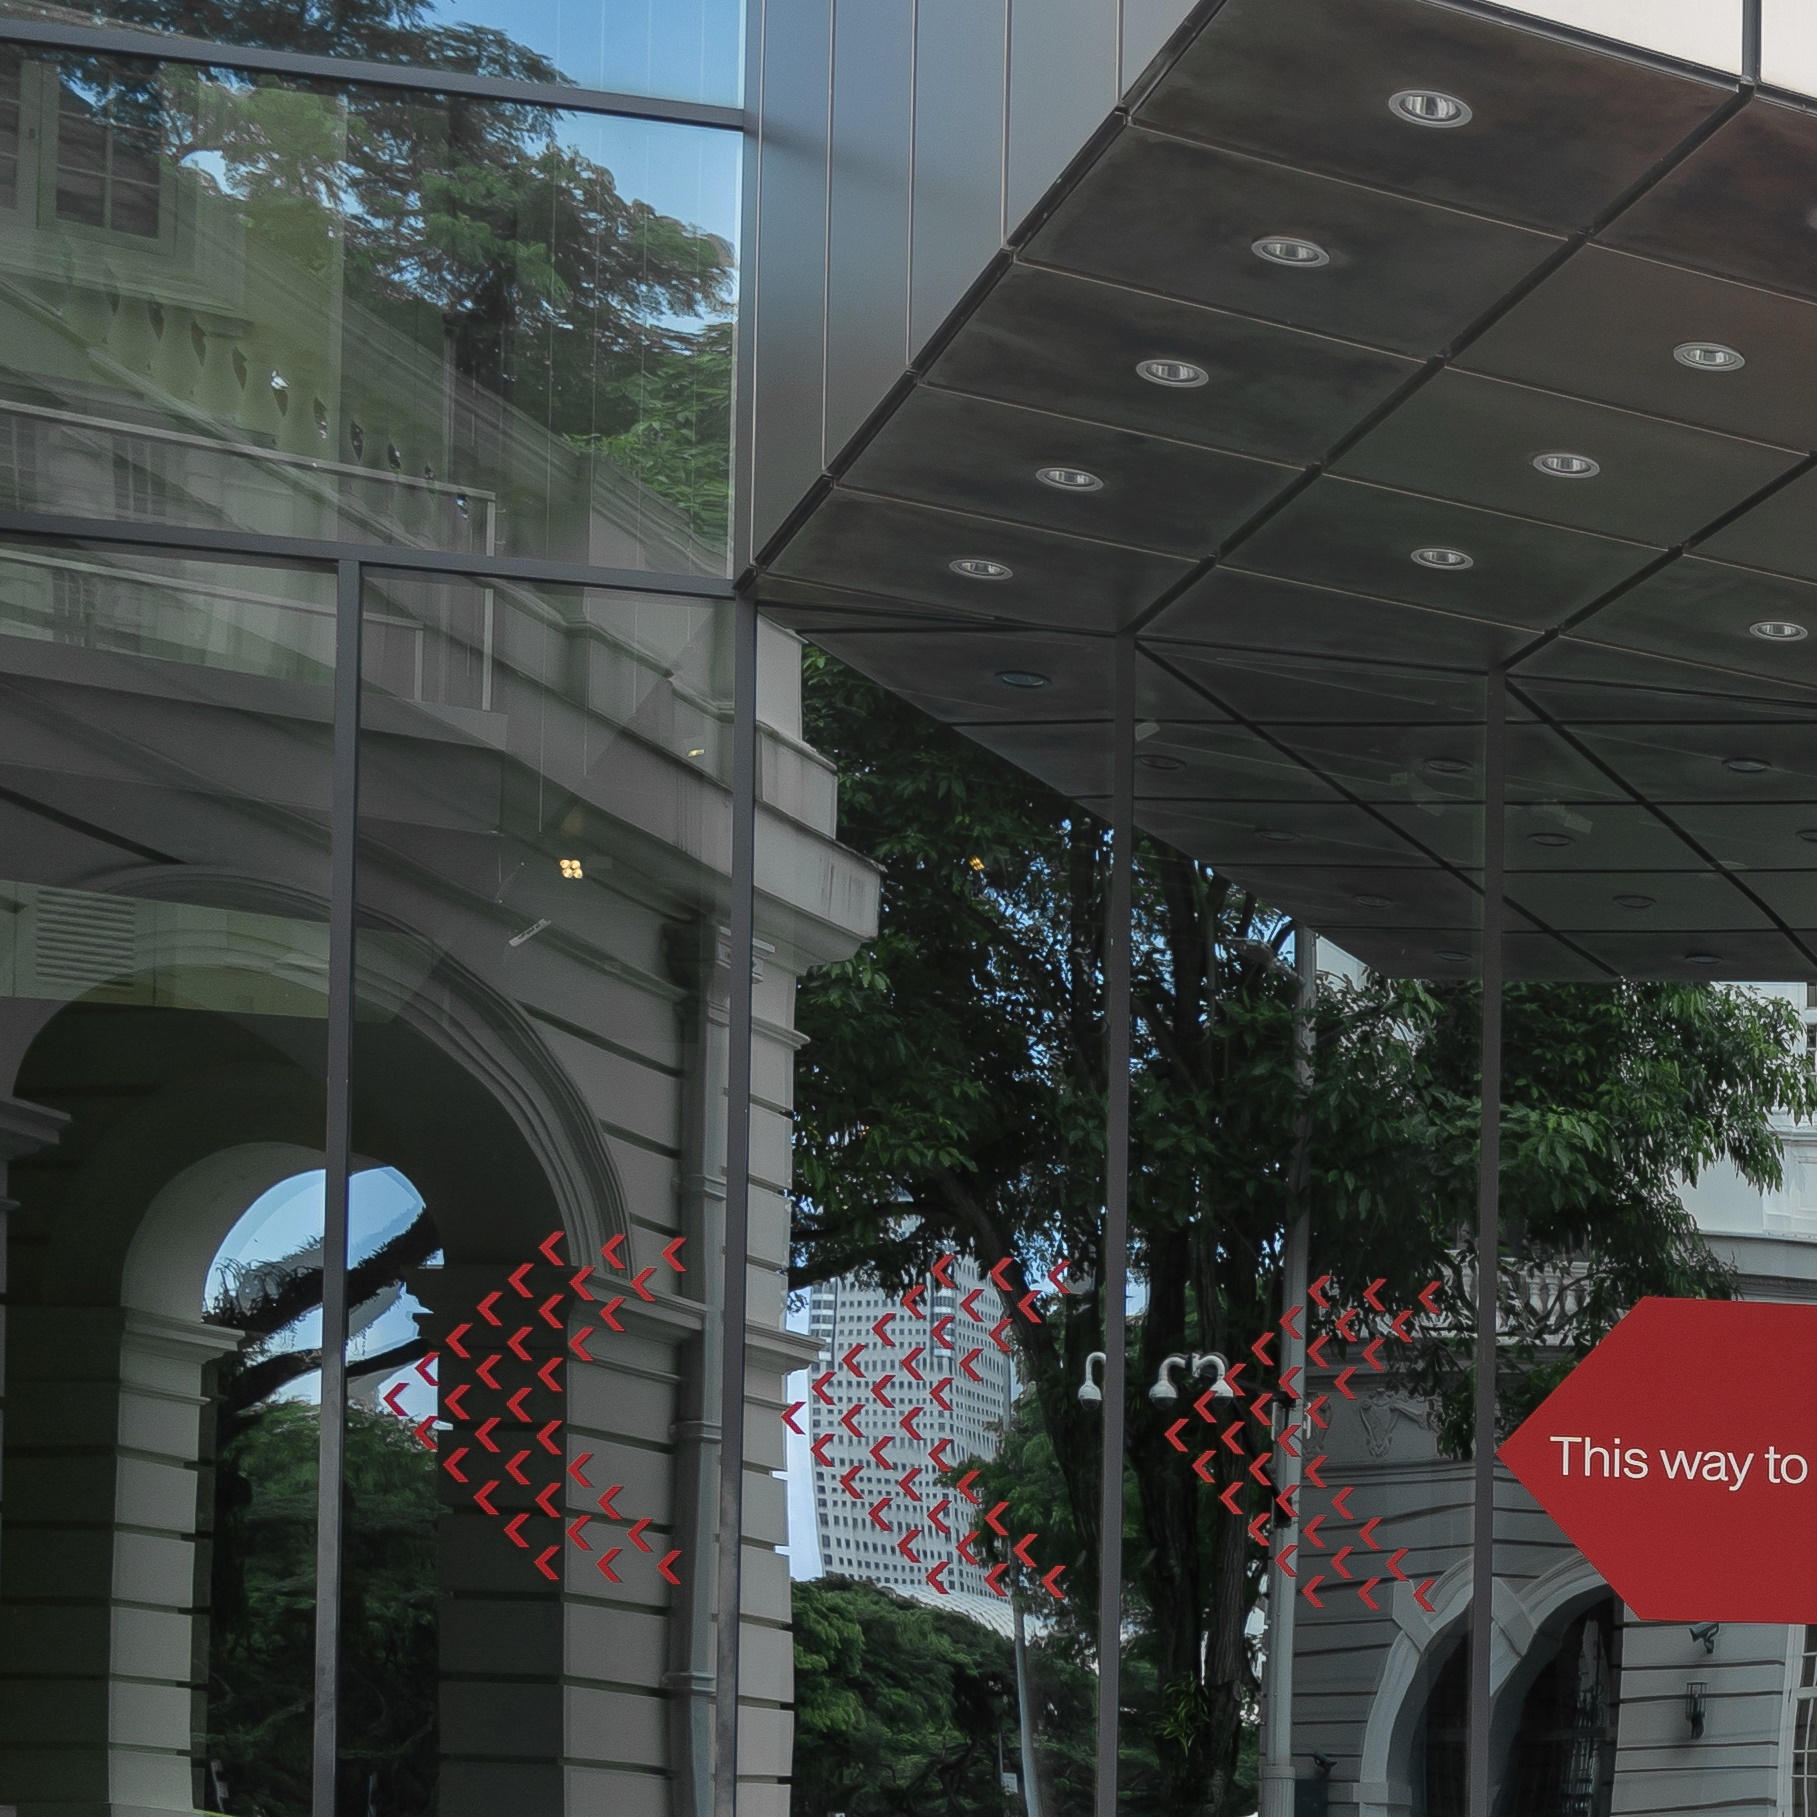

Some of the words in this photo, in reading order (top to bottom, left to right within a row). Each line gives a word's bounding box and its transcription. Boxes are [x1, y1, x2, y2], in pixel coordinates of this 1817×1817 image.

[1550, 1436, 1649, 1479] This
[1660, 1449, 1754, 1491] way
[1764, 1446, 1808, 1484] to
